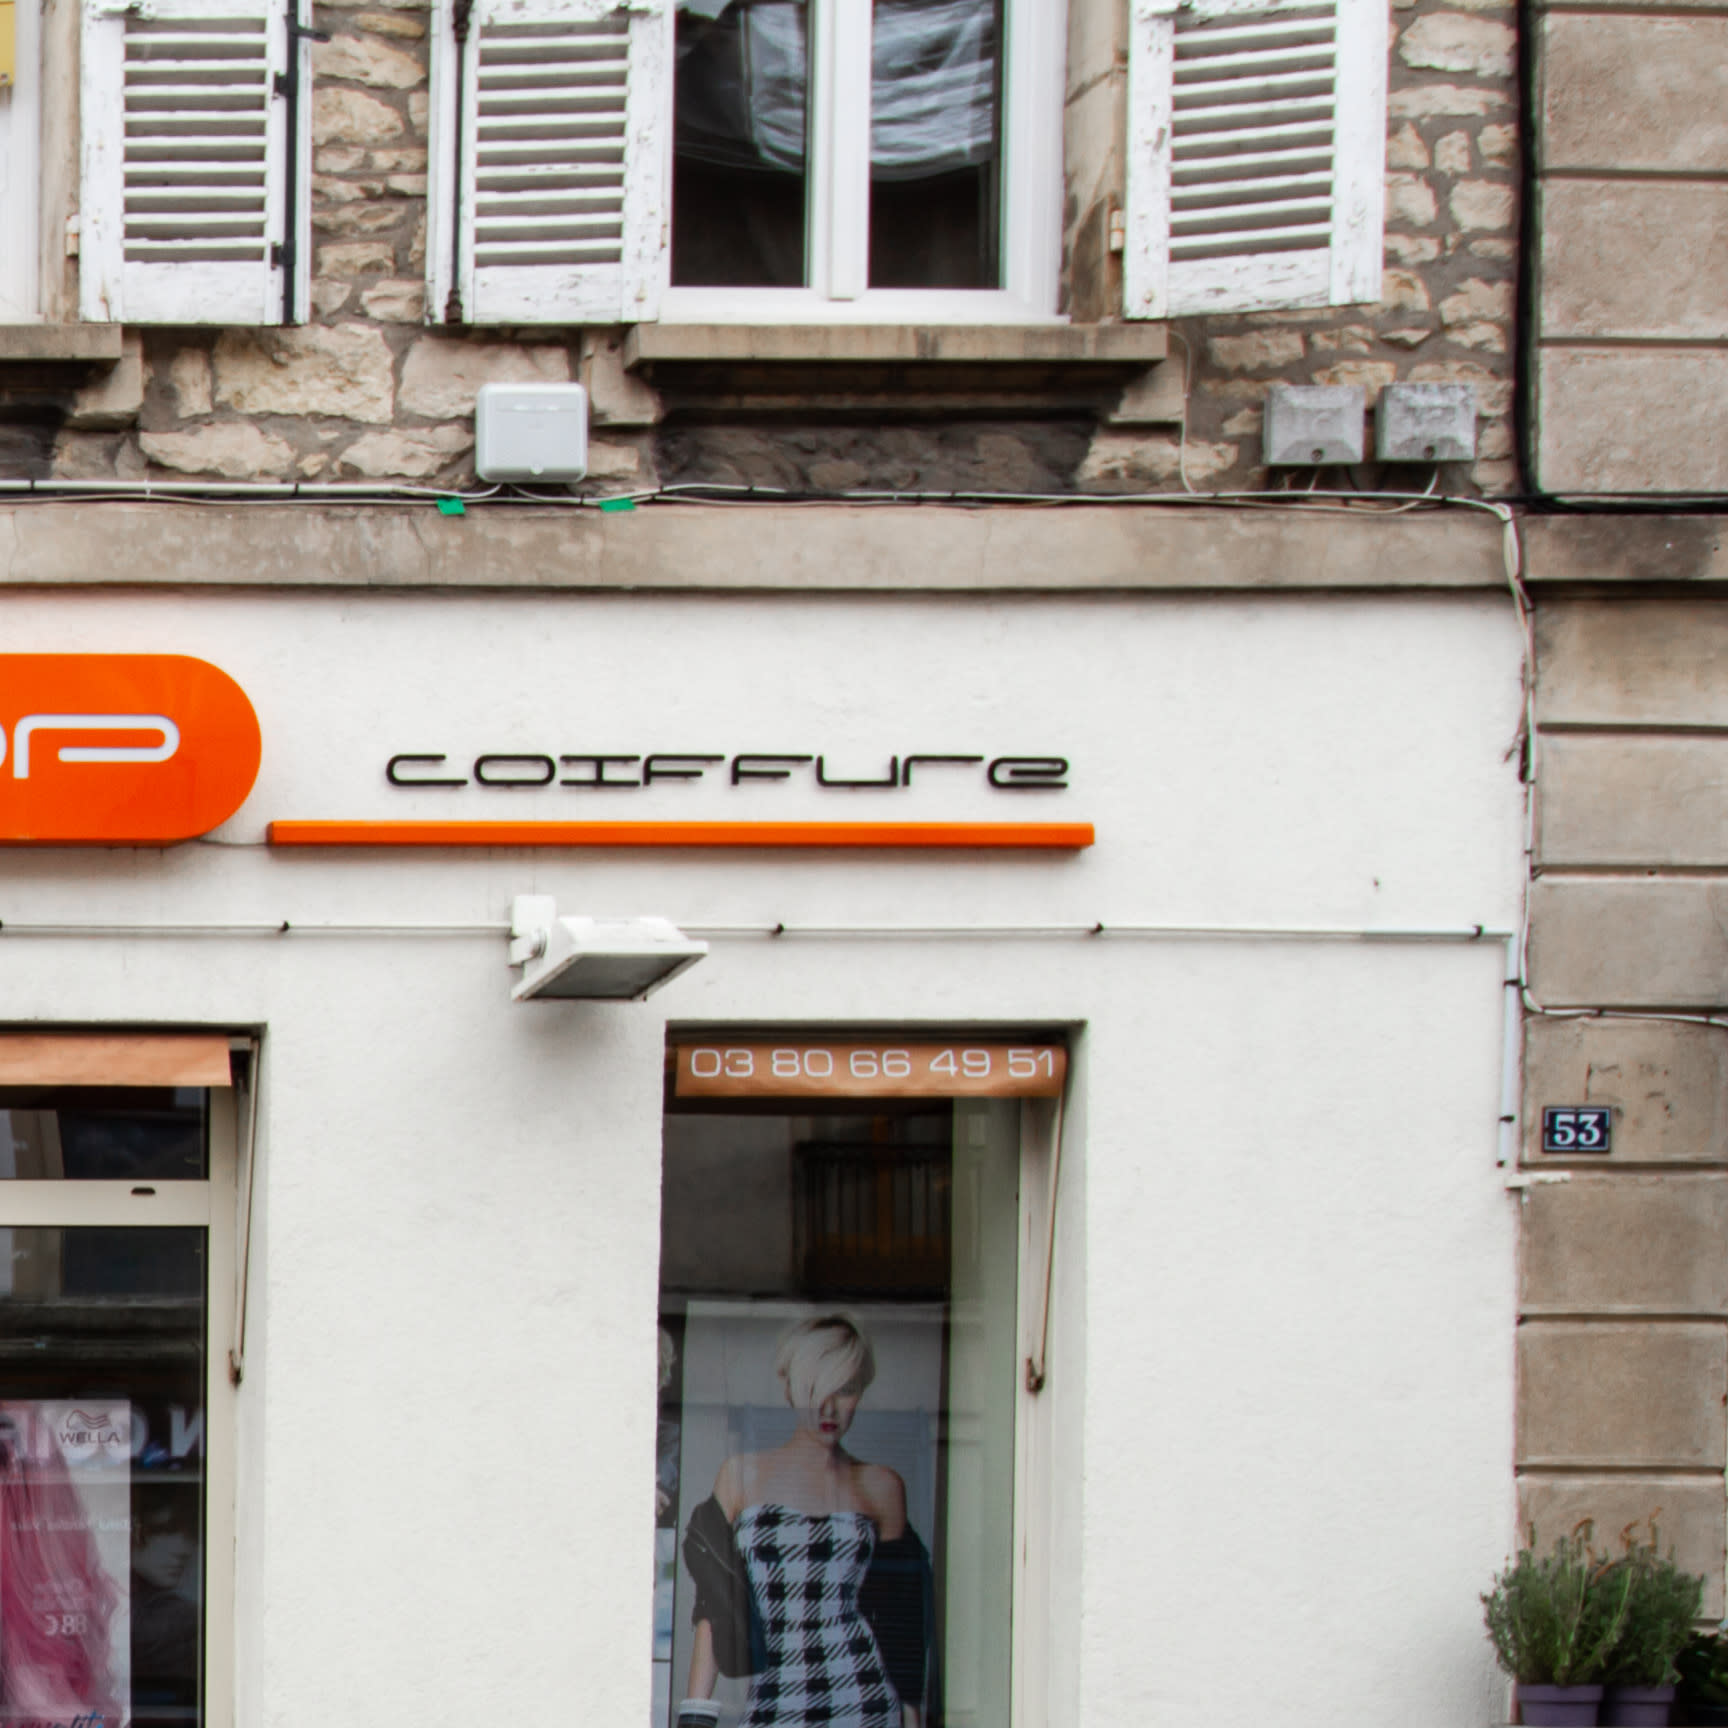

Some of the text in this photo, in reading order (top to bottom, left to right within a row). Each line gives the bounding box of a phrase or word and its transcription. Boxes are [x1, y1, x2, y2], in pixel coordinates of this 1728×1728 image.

[691, 1049, 1055, 1078] 03 80 66 49 51
[1553, 1114, 1601, 1145] 53
[59, 1432, 121, 1445] WELLA
